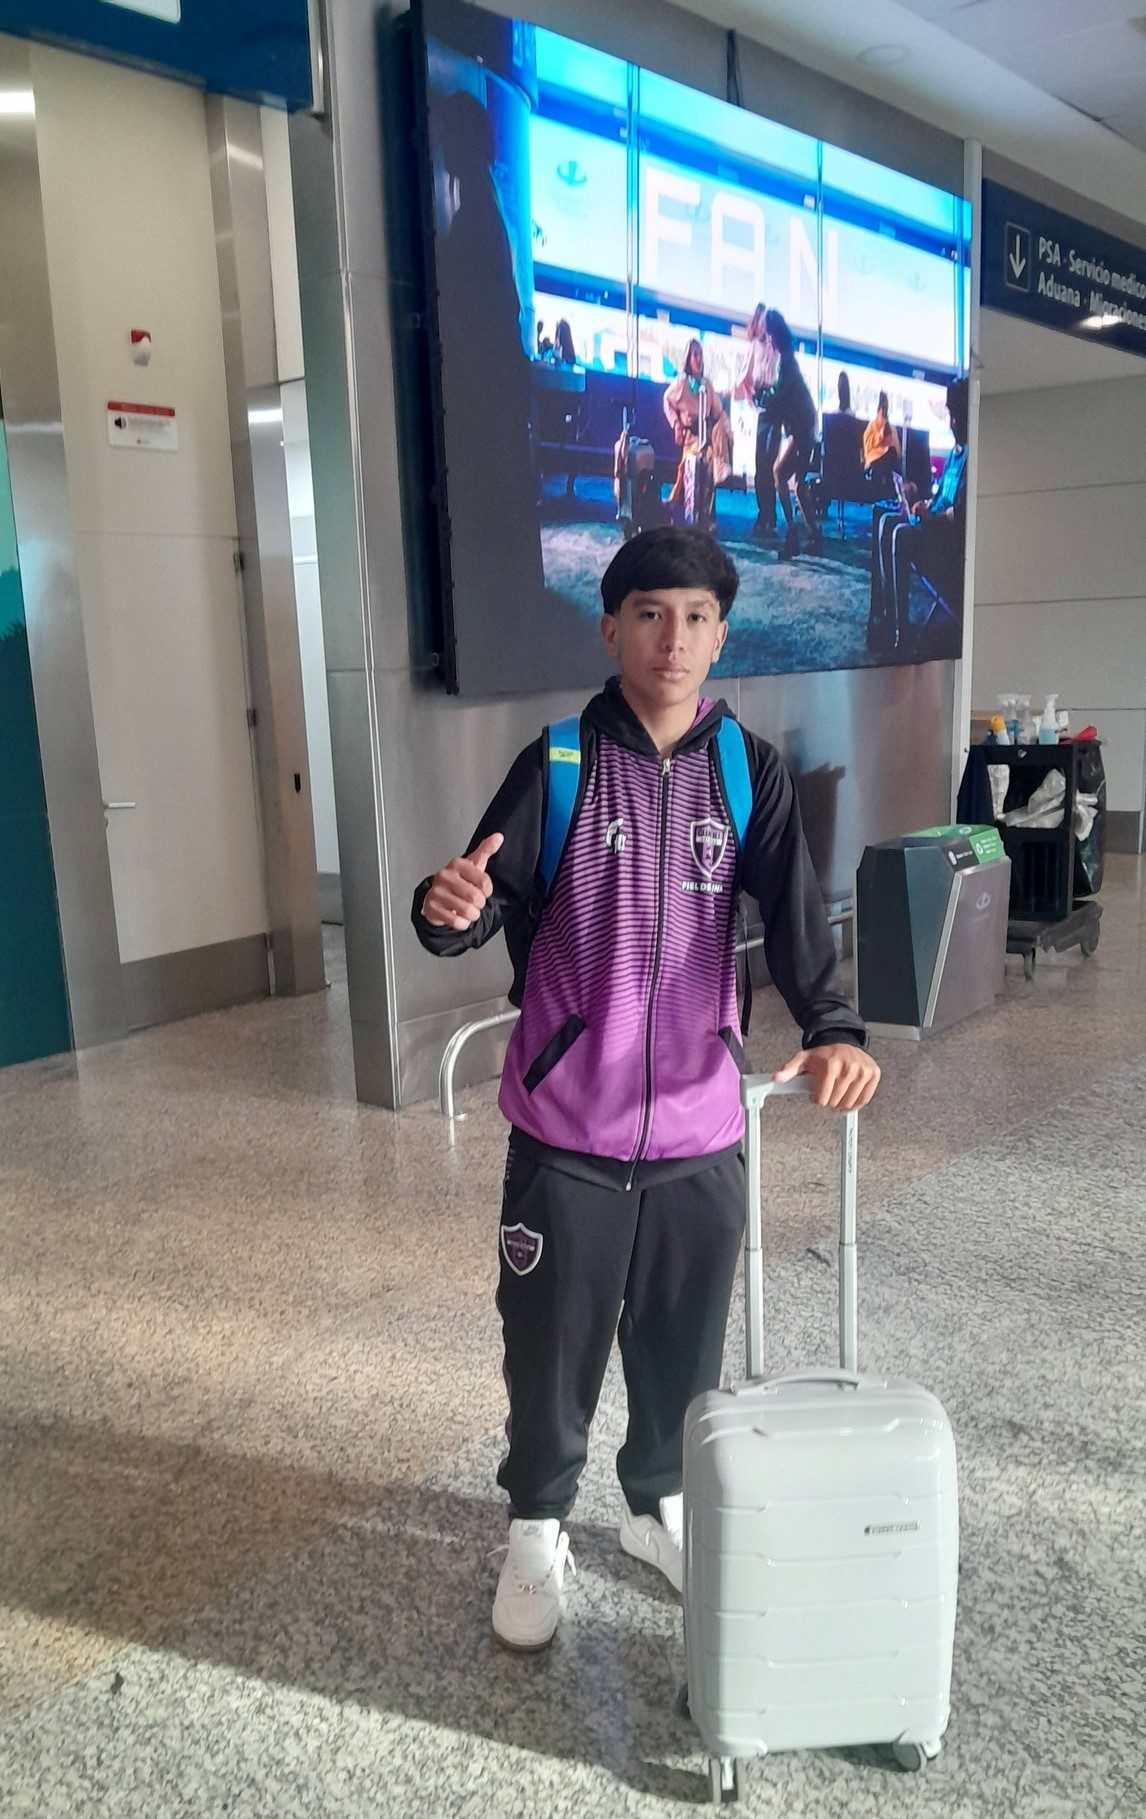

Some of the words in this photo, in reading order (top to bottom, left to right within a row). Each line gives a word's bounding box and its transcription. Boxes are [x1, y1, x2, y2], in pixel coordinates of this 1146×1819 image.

[644, 167, 839, 325] FAN
[1038, 236, 1061, 266] PSA
[1068, 249, 1110, 285] Servicio
[1037, 271, 1081, 307] Aduana
